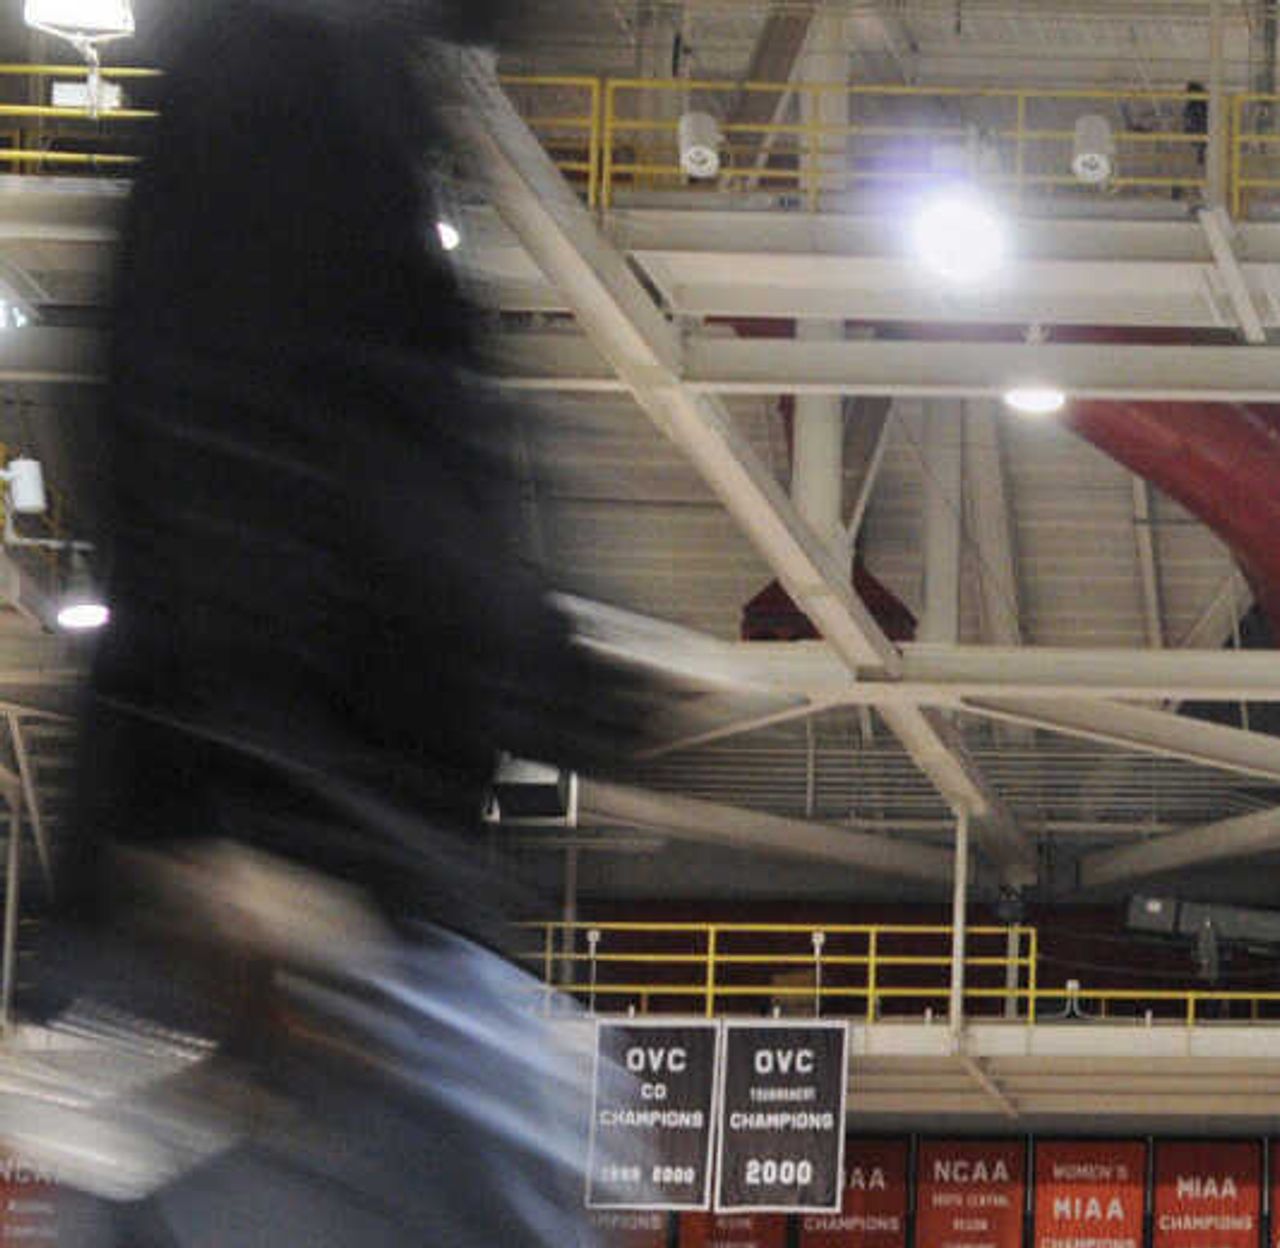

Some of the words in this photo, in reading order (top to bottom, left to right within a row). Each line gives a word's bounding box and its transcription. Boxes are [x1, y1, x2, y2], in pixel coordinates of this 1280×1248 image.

[626, 1048, 687, 1073] OVC
[755, 1050, 815, 1074] OVC
[600, 1110, 703, 1127] CHAMPIONS
[729, 1112, 834, 1130] CHAMPIONS
[652, 1165, 694, 1184] 2000
[746, 1160, 813, 1185] 2000
[849, 1166, 885, 1190] AA
[933, 1160, 1009, 1183] NCAA
[1177, 1175, 1237, 1199] MIAA
[1053, 1197, 1125, 1220] MIAA
[804, 1215, 899, 1231] CHAMPIONS
[1159, 1215, 1253, 1231] CHAMPIONS
